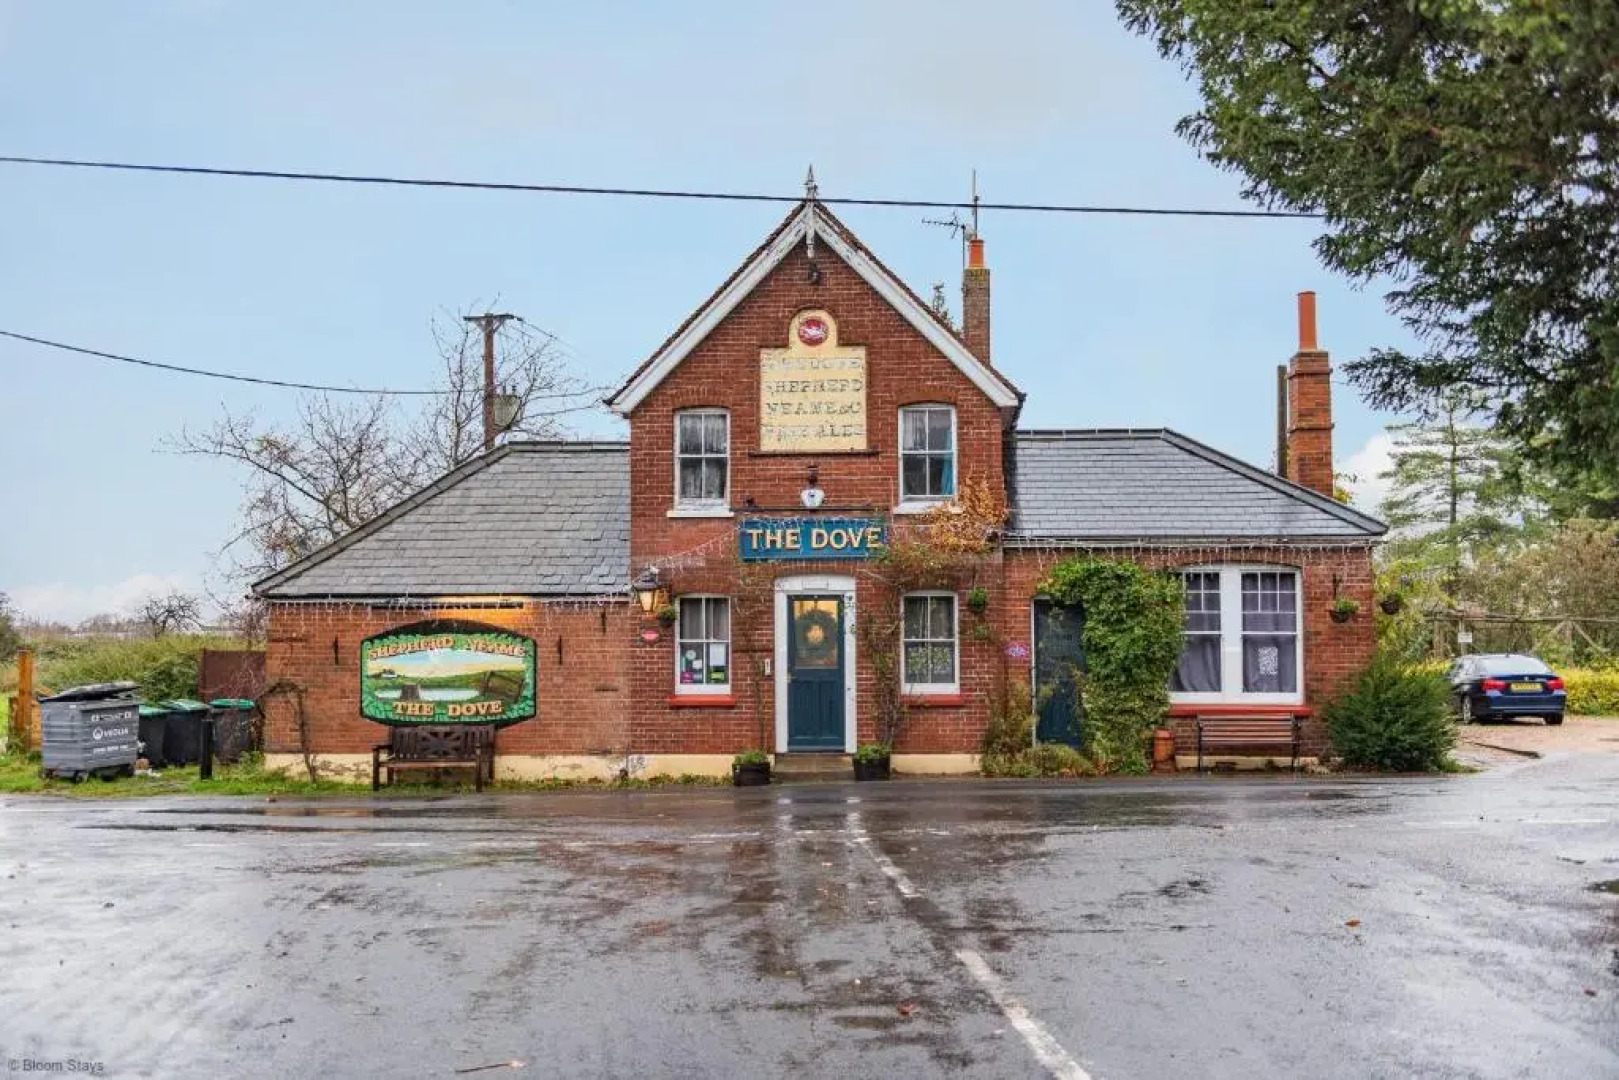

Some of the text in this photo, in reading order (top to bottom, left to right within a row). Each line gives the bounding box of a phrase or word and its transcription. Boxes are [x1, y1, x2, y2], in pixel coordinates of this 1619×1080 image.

[746, 527, 882, 548] THE DOVE
[368, 636, 526, 659] SHEPHERD NEAME
[392, 700, 503, 716] THE DOVE
